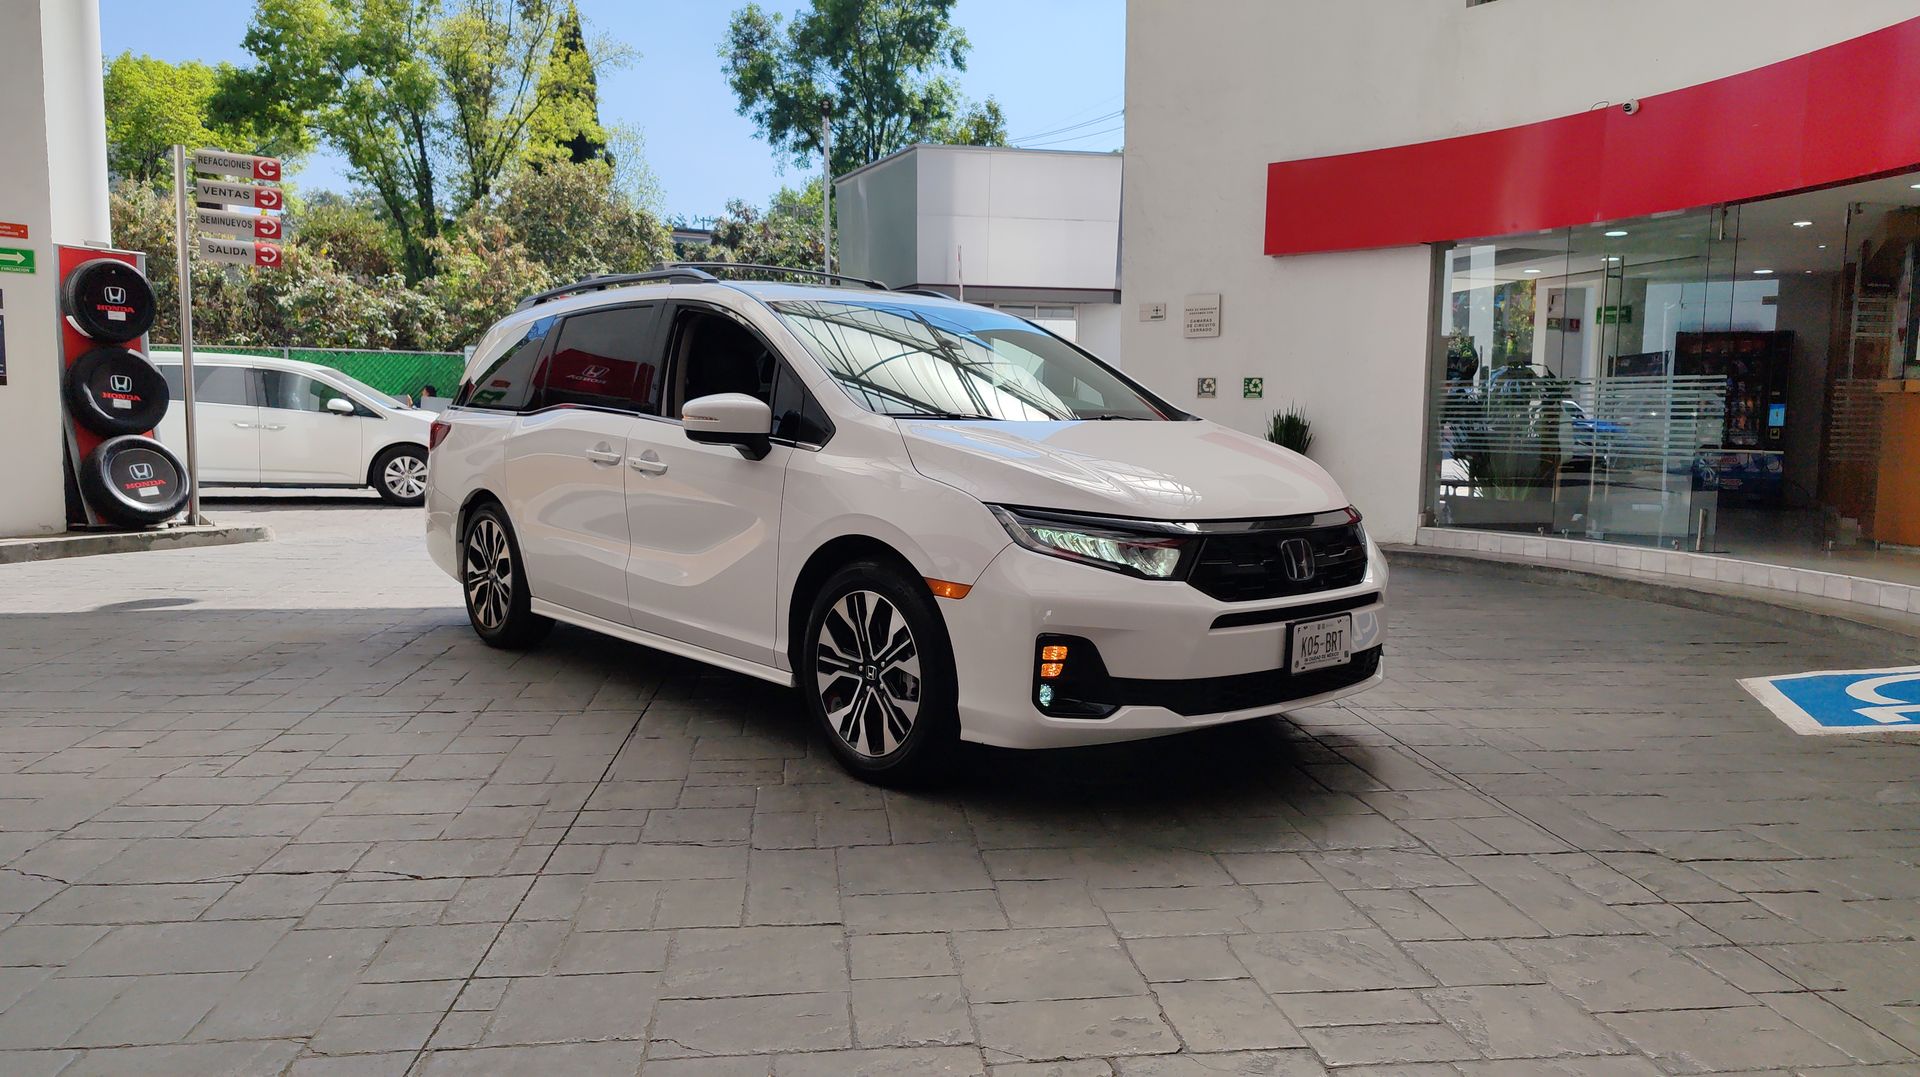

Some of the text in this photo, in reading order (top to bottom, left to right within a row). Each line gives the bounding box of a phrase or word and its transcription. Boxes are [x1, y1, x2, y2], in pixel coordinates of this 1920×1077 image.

[197, 155, 252, 170] REFACCIONES
[202, 186, 250, 200] VENTAS
[200, 214, 253, 229] SEMINUEVOS
[208, 244, 248, 257] SALIDA
[96, 304, 135, 313] HONDA
[102, 392, 141, 401] HONDA
[125, 479, 166, 489] HONDA
[1301, 630, 1343, 658] K05-BRT
